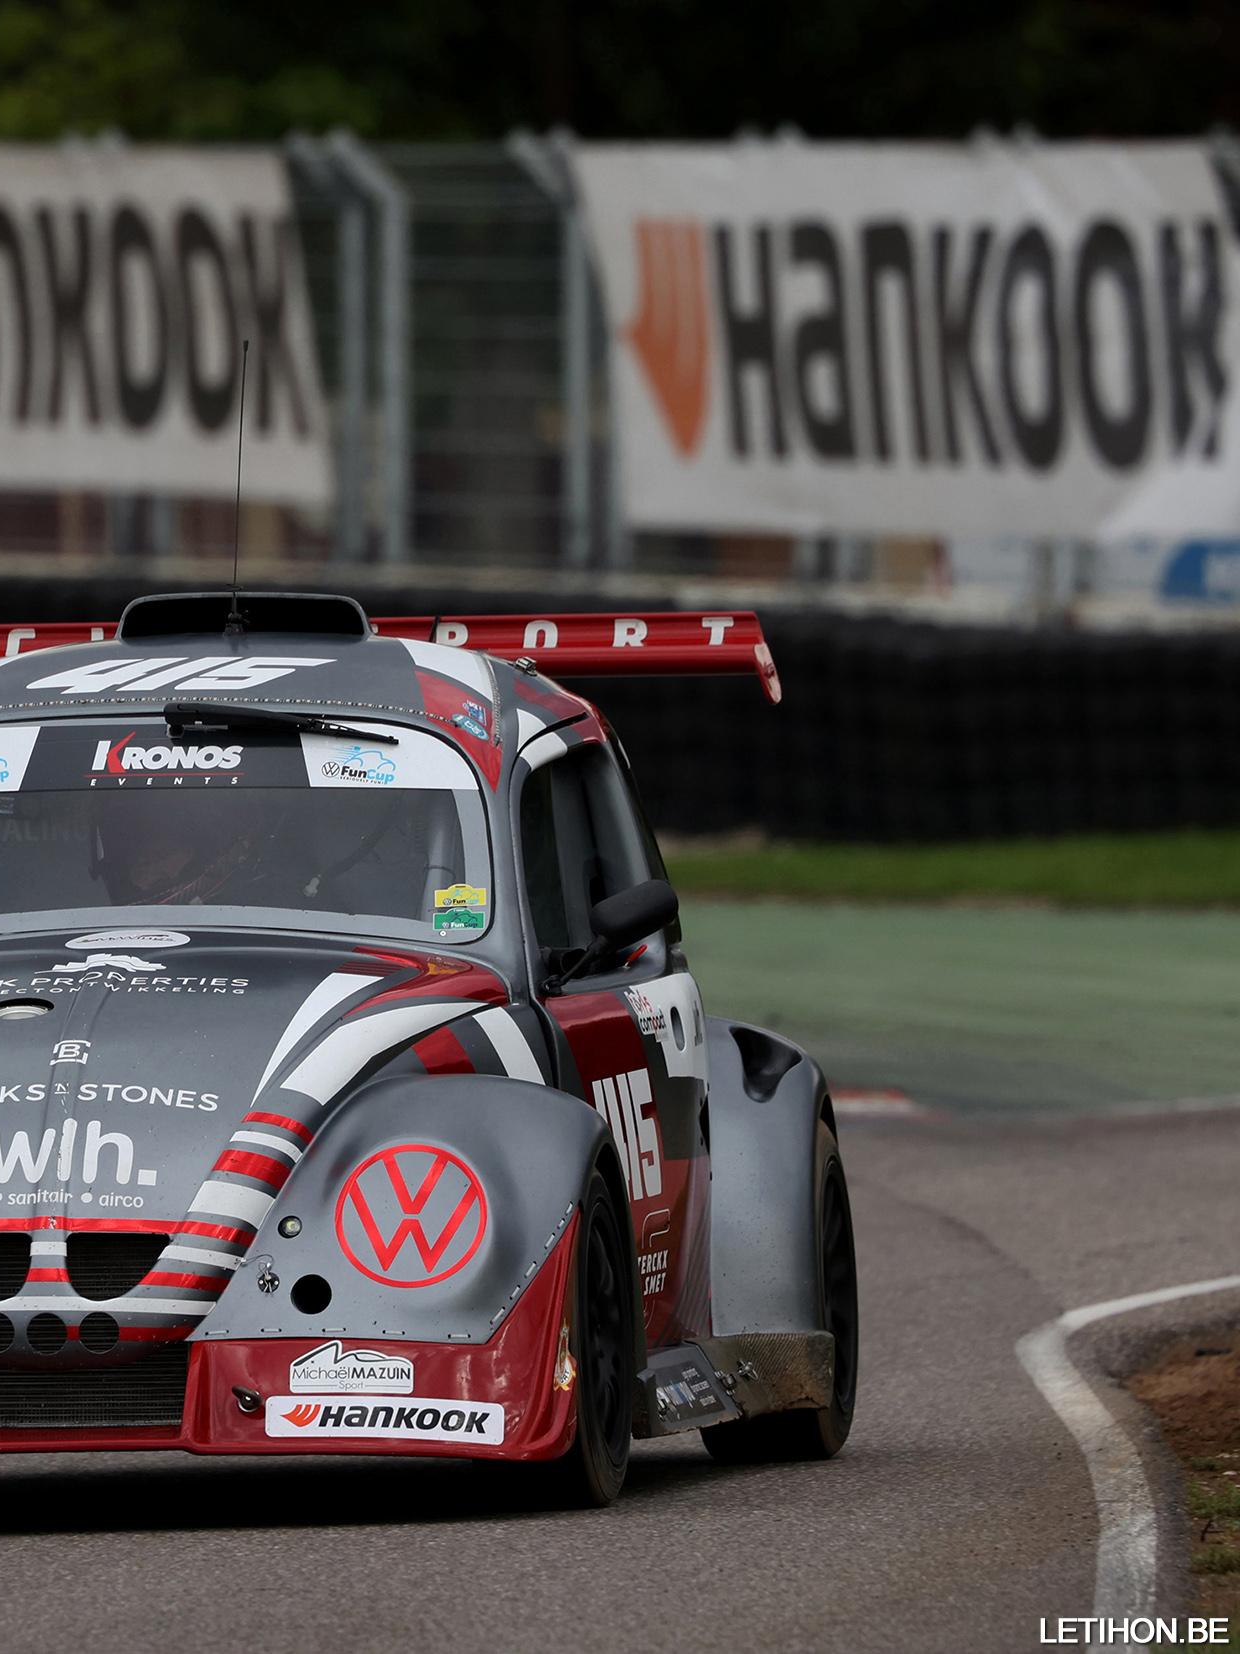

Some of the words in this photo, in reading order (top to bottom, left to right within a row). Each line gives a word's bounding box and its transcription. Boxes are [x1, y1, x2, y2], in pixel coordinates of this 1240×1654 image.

[26, 656, 338, 695] 415
[91, 731, 244, 773] KRONOS
[90, 776, 241, 787] EVENTS
[341, 765, 395, 785] FunCup
[30, 970, 250, 987] PROPERTIES
[77, 1083, 220, 1112] STONES
[7, 1188, 73, 1206] sanitair
[98, 1192, 144, 1208] airco
[643, 1272, 667, 1296] SMET
[338, 1380, 364, 1390] Sport
